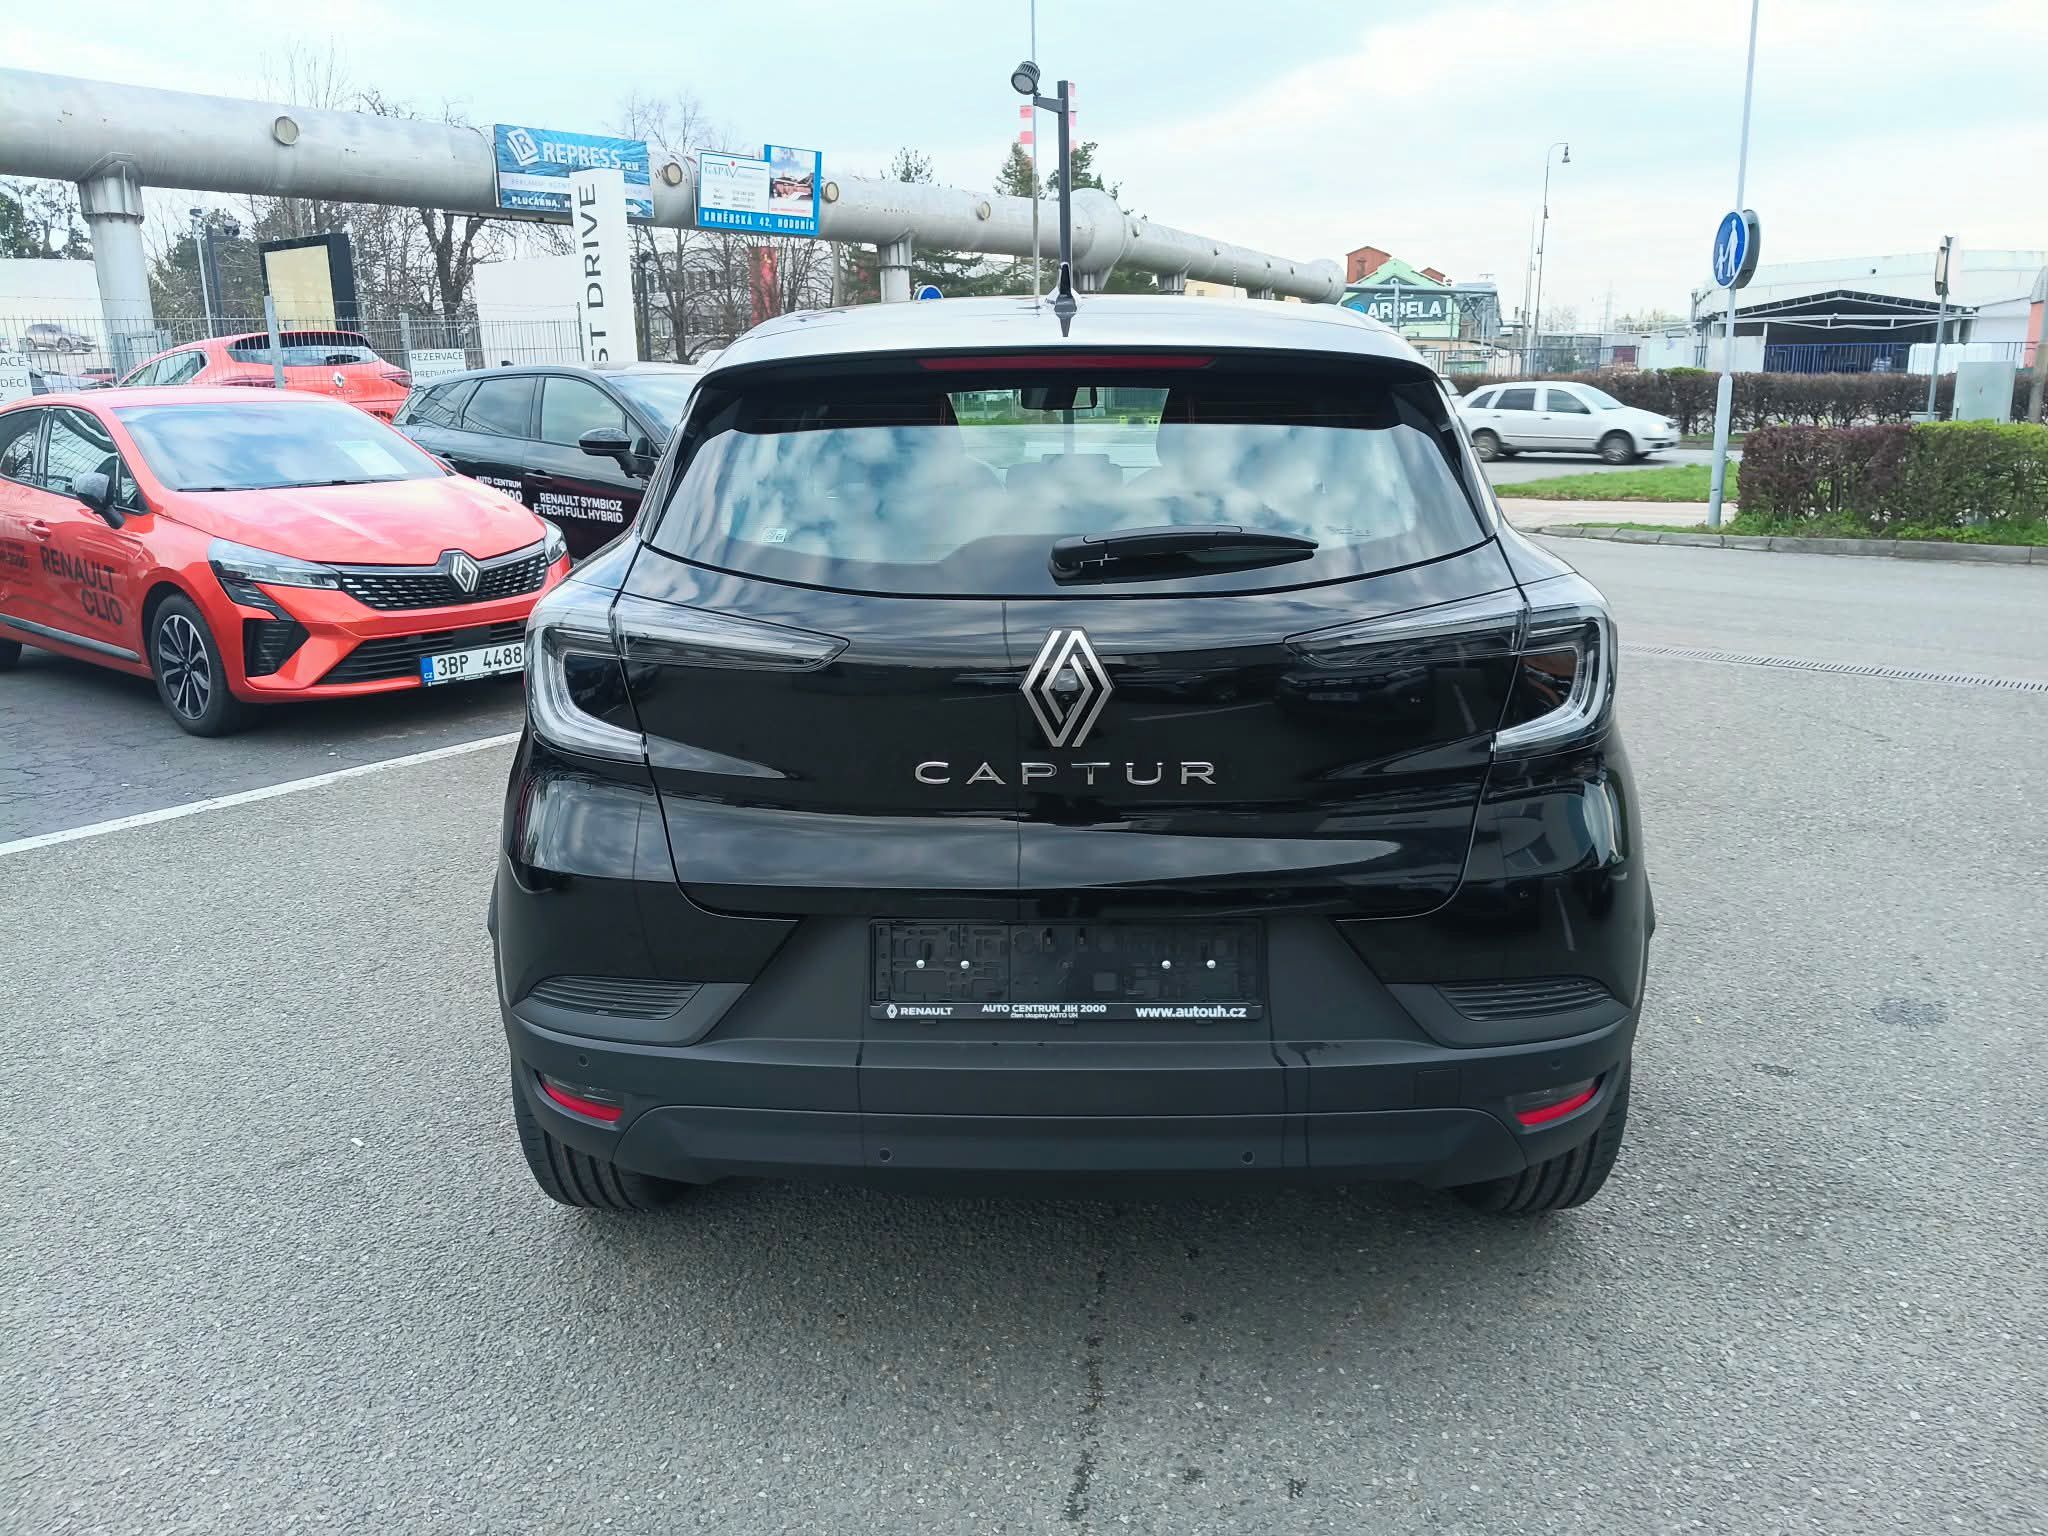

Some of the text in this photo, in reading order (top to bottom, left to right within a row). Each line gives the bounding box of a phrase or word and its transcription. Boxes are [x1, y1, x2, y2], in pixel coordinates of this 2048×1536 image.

[542, 141, 640, 172] REPRESS.eu
[578, 183, 604, 310] DRIVE
[411, 351, 464, 361] REZERVACE
[493, 477, 522, 489] CENTRUM
[540, 493, 623, 512] RENAULT SYMBIOZ
[533, 504, 624, 524] E-TECH FULL HYBRID
[39, 545, 116, 595] RENAULT
[81, 587, 123, 626] CLIO
[437, 654, 469, 676] 3BP
[483, 646, 523, 669] 4488
[914, 761, 1217, 786] CAPTUR
[900, 1006, 954, 1016] RENAULT
[981, 1004, 1107, 1013] AUTO CENTRUM JIH 2000
[1135, 1005, 1247, 1018] www.autouh.cz
